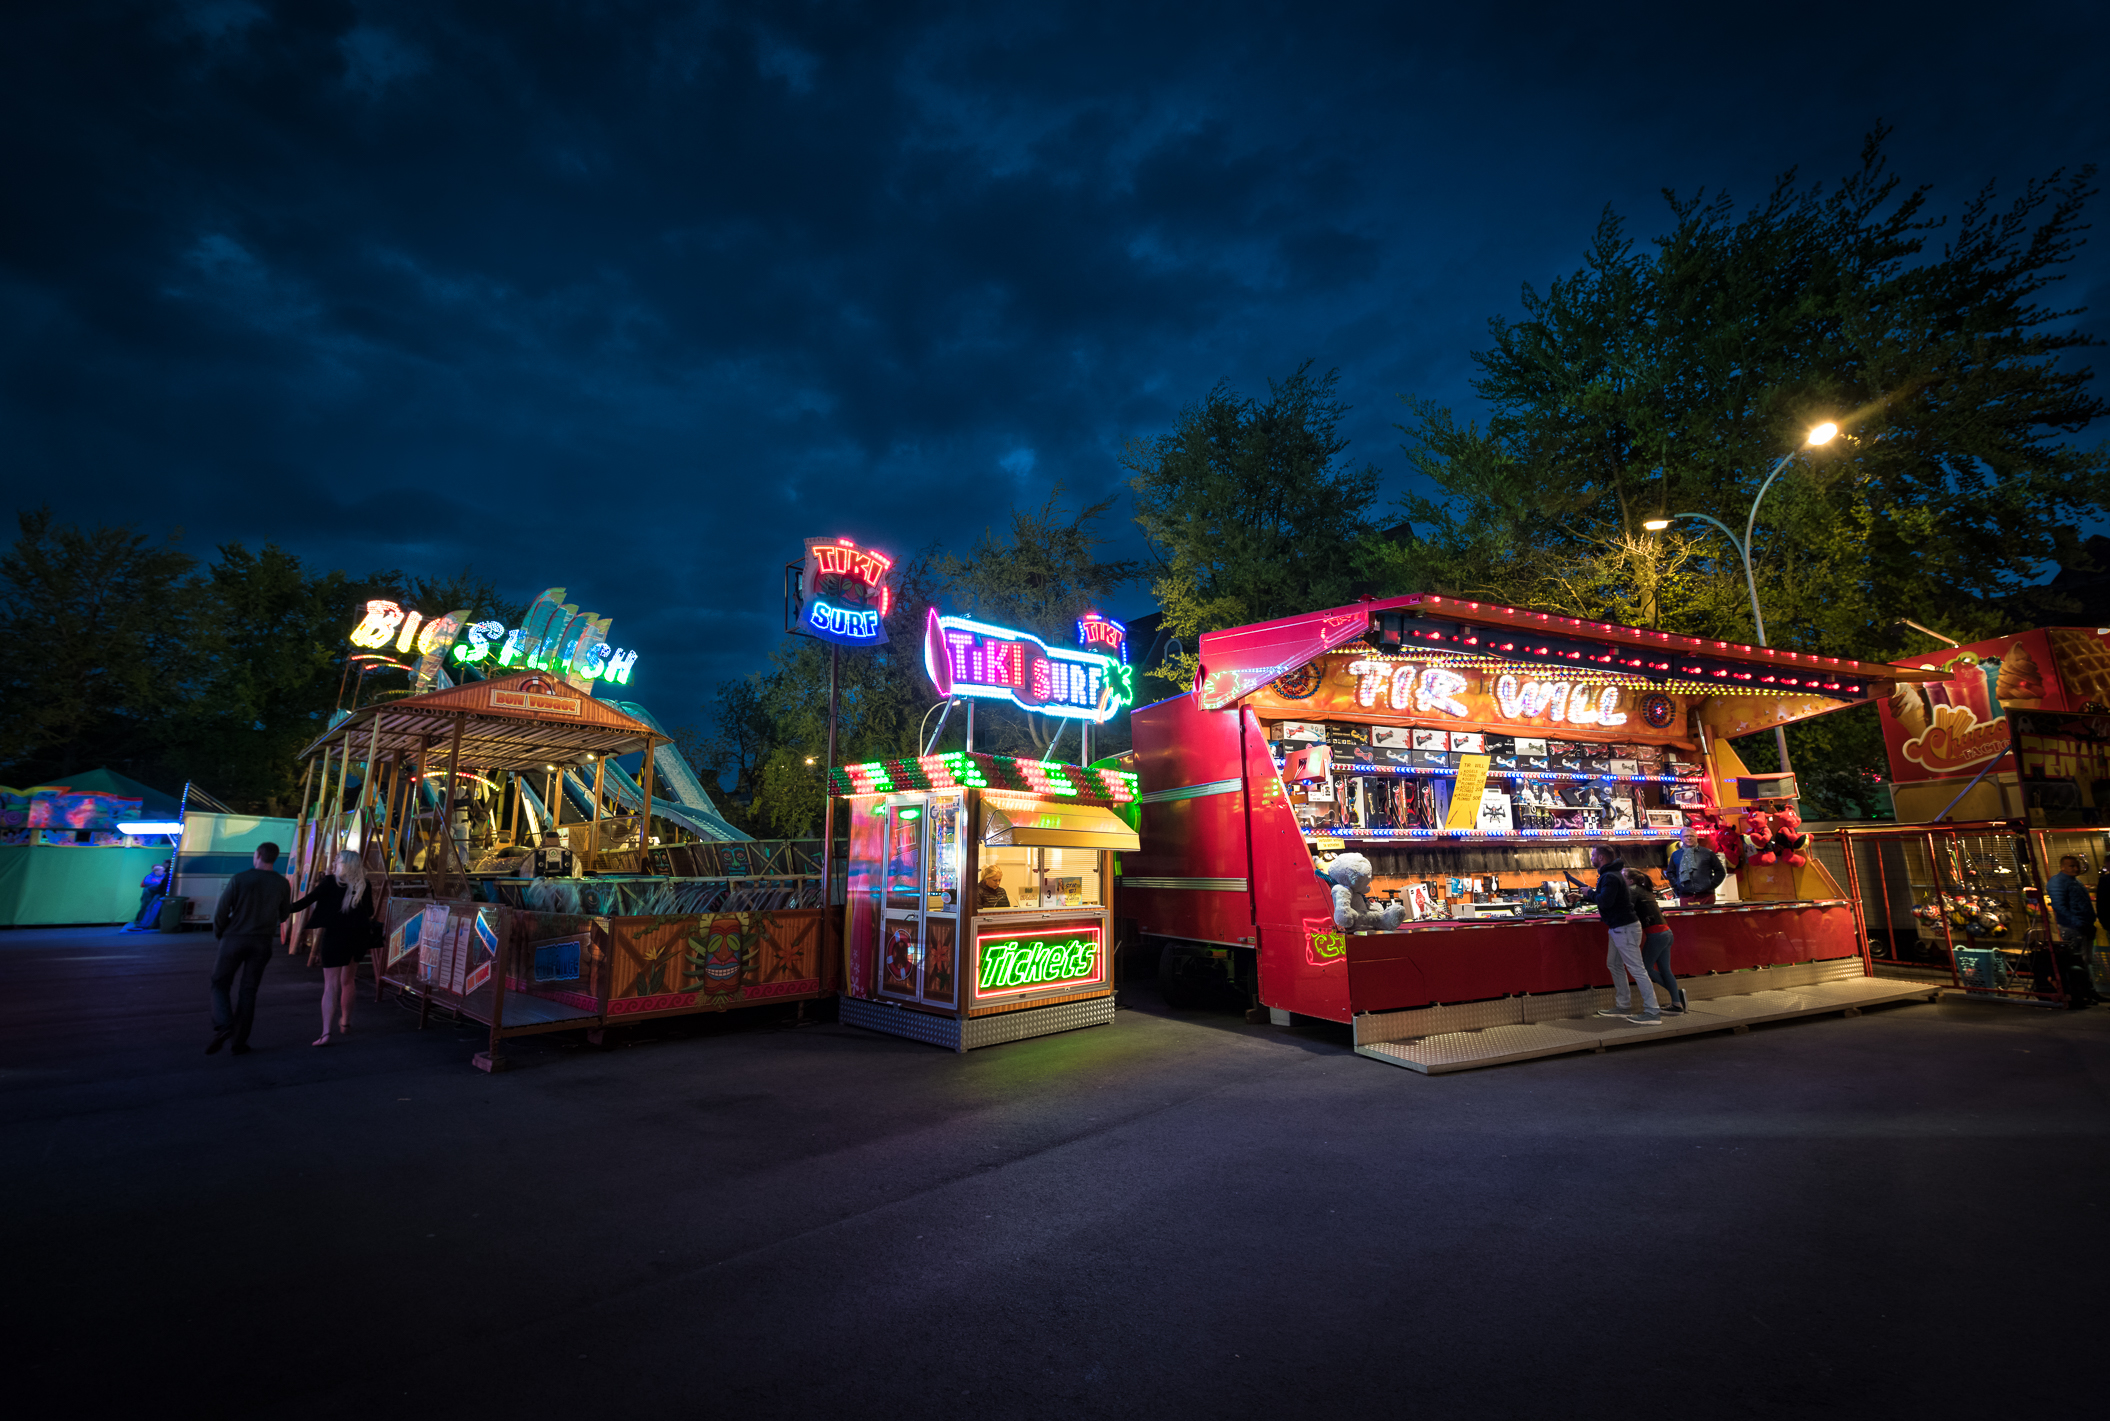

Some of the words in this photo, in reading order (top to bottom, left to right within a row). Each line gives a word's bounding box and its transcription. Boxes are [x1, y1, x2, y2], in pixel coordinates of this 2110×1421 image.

[812, 546, 883, 587] TIKI
[350, 600, 459, 656] BIG
[454, 620, 639, 685] SPLASH
[810, 602, 878, 638] SURF
[1083, 621, 1123, 649] TIKI
[1032, 658, 1102, 705] SURF
[1348, 660, 1469, 718] TIR
[1498, 674, 1628, 727] WILL
[980, 939, 1097, 989] Tickets
